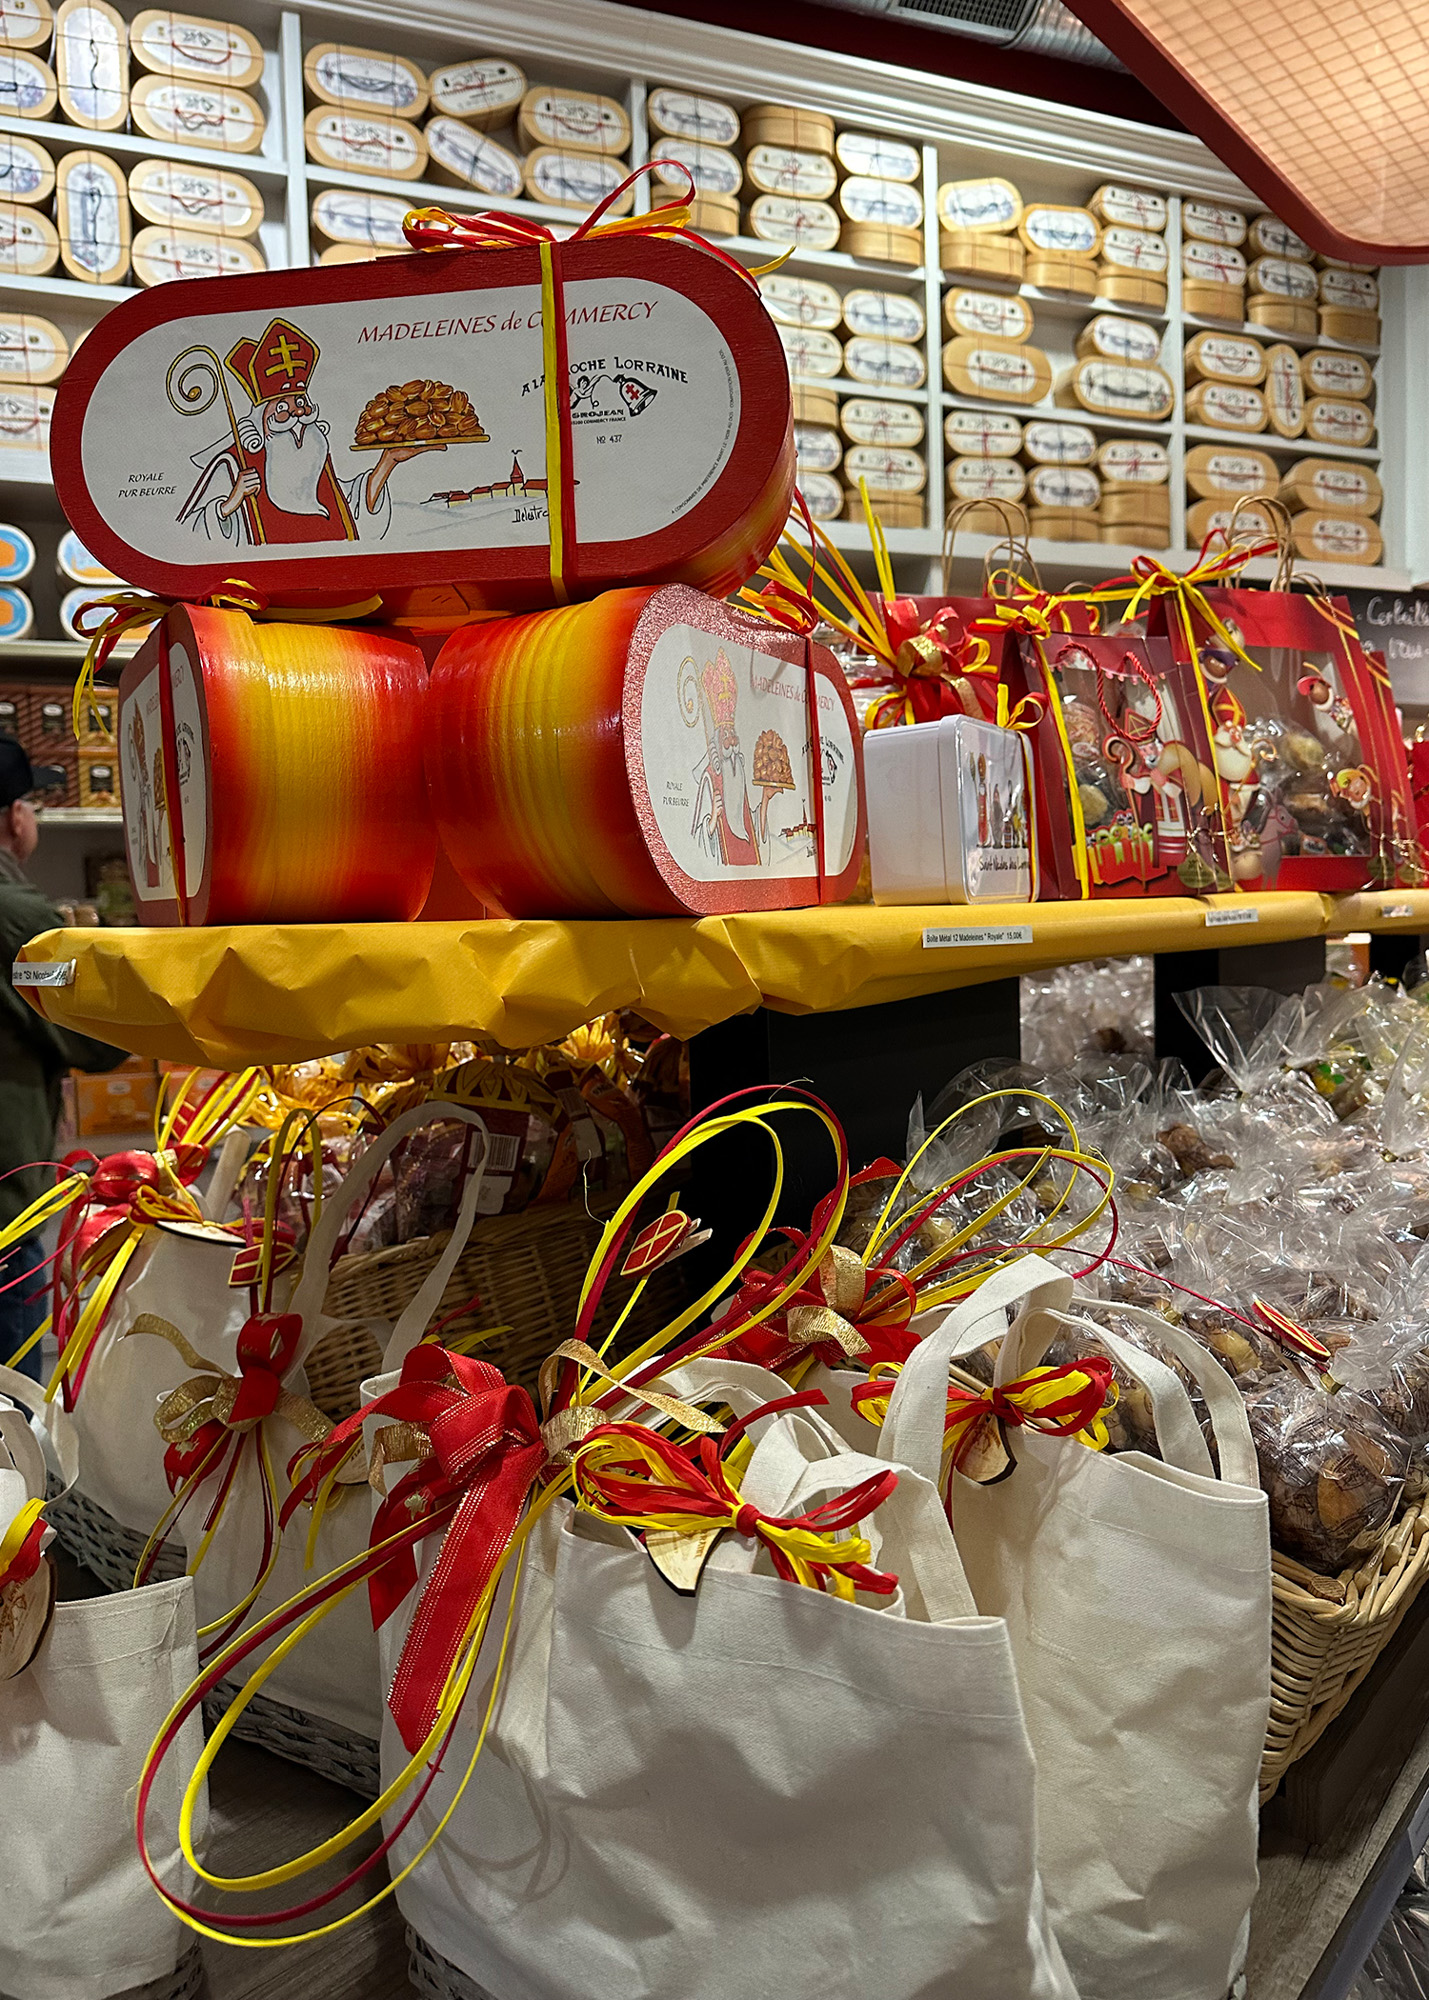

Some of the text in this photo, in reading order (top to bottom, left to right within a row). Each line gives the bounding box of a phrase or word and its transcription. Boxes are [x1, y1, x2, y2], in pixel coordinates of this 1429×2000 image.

[357, 315, 497, 344] MADELEINES
[501, 311, 522, 331] de
[521, 383, 531, 397] A
[614, 356, 689, 384] LORRAINE
[572, 409, 624, 419] GROJEAN
[609, 434, 623, 444] 437
[128, 472, 165, 483] ROYALE
[118, 485, 178, 498] PUR BEURRE
[750, 674, 794, 700] MADELEINES
